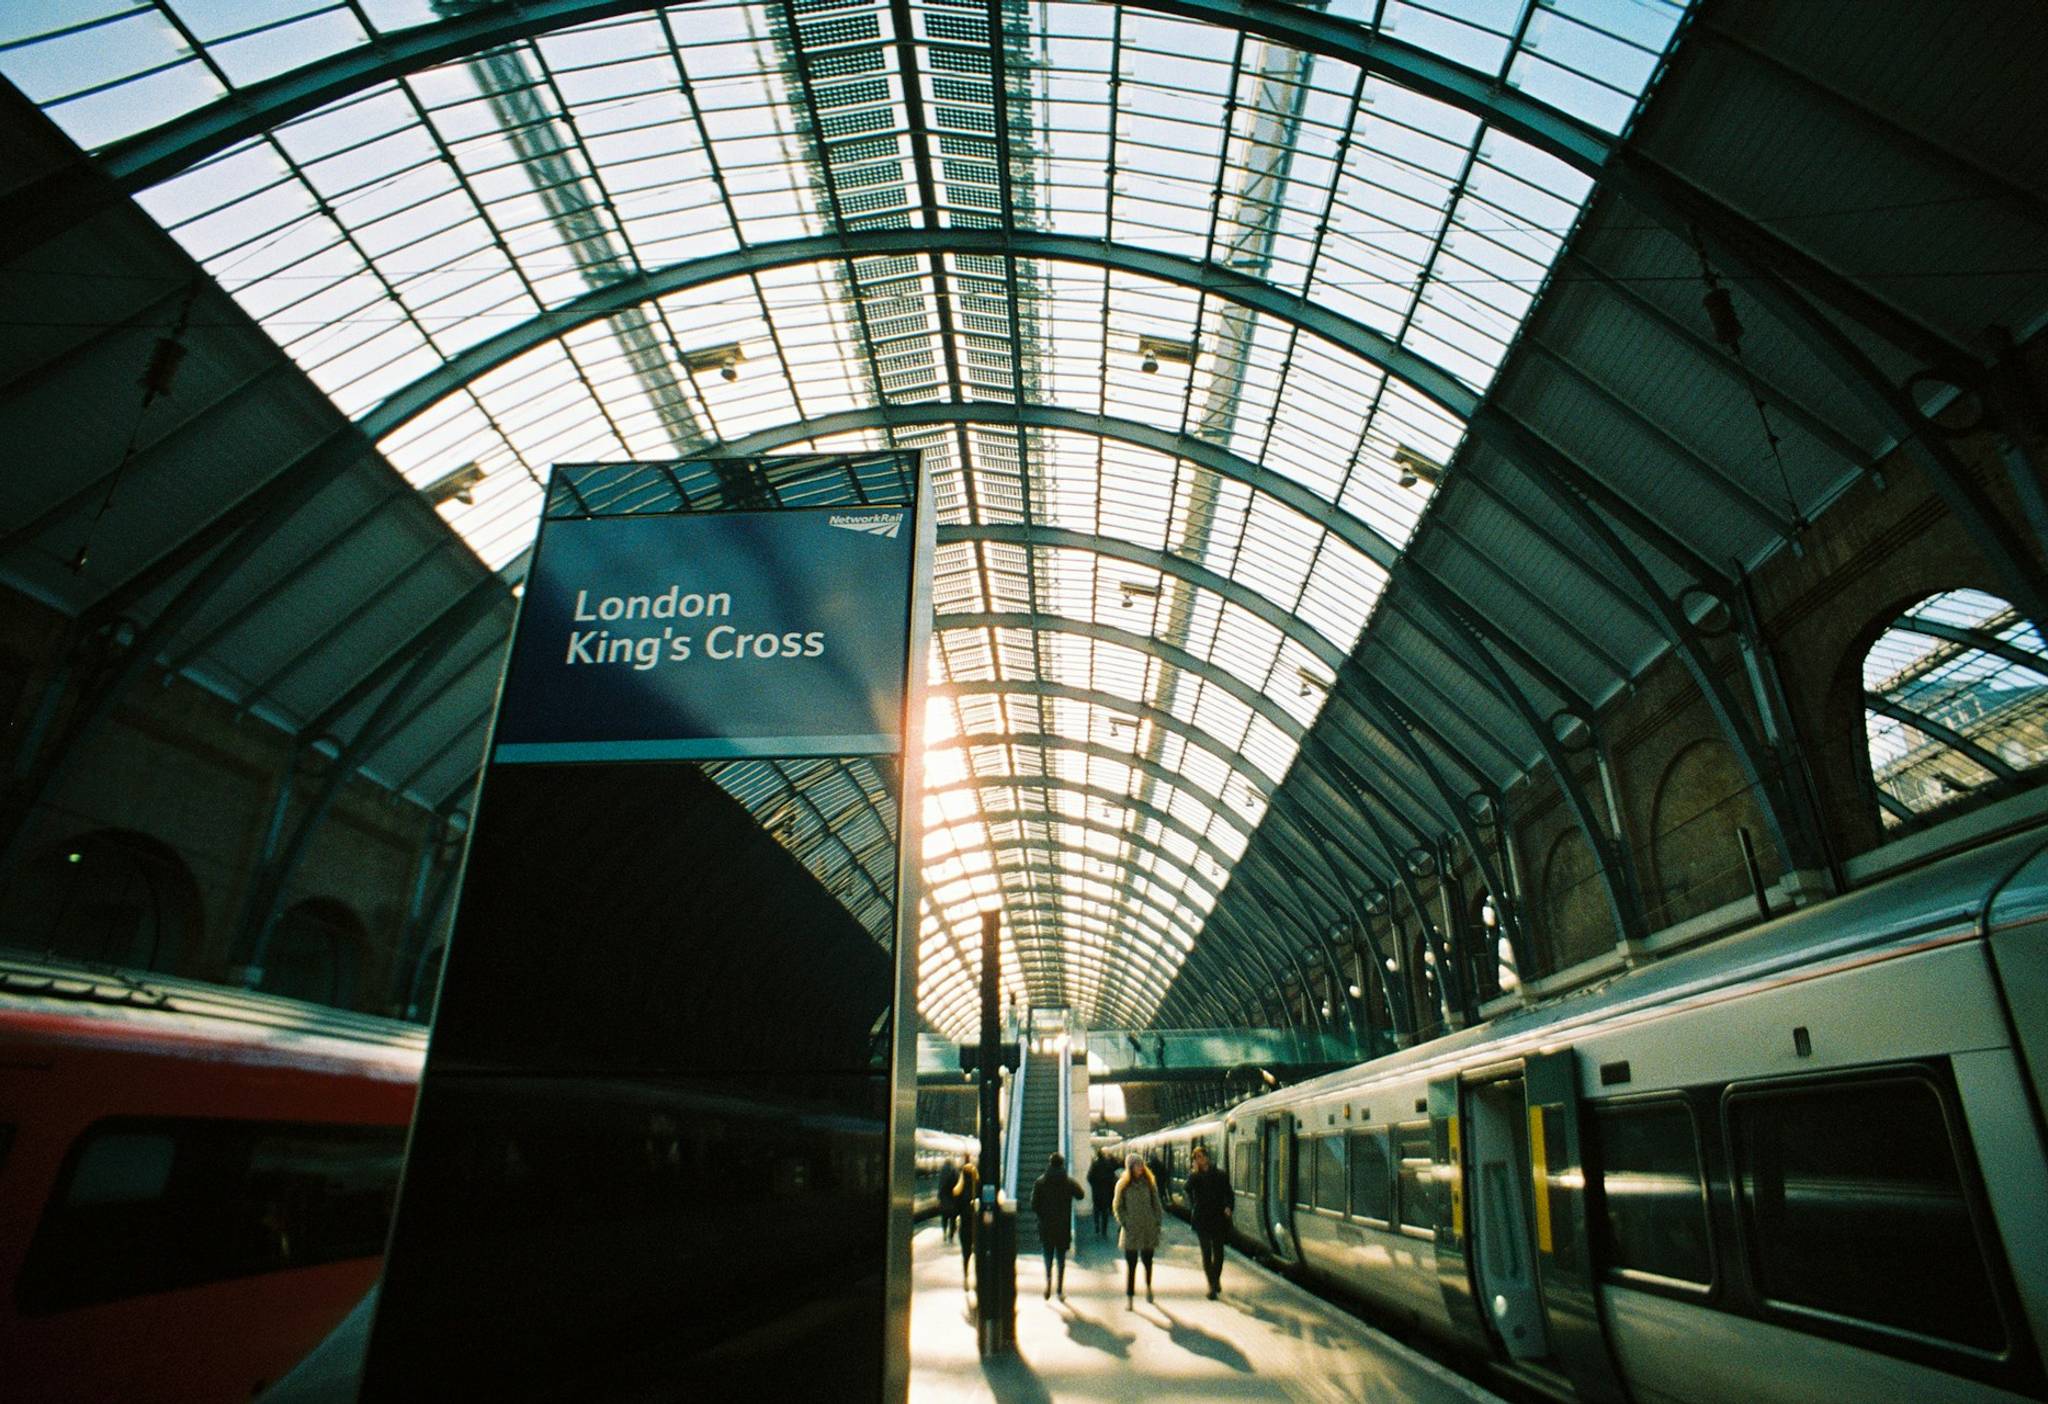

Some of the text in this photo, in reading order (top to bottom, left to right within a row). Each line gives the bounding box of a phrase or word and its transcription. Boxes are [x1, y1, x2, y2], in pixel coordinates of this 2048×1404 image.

[574, 585, 731, 622] London
[565, 625, 826, 671] King's Cross
